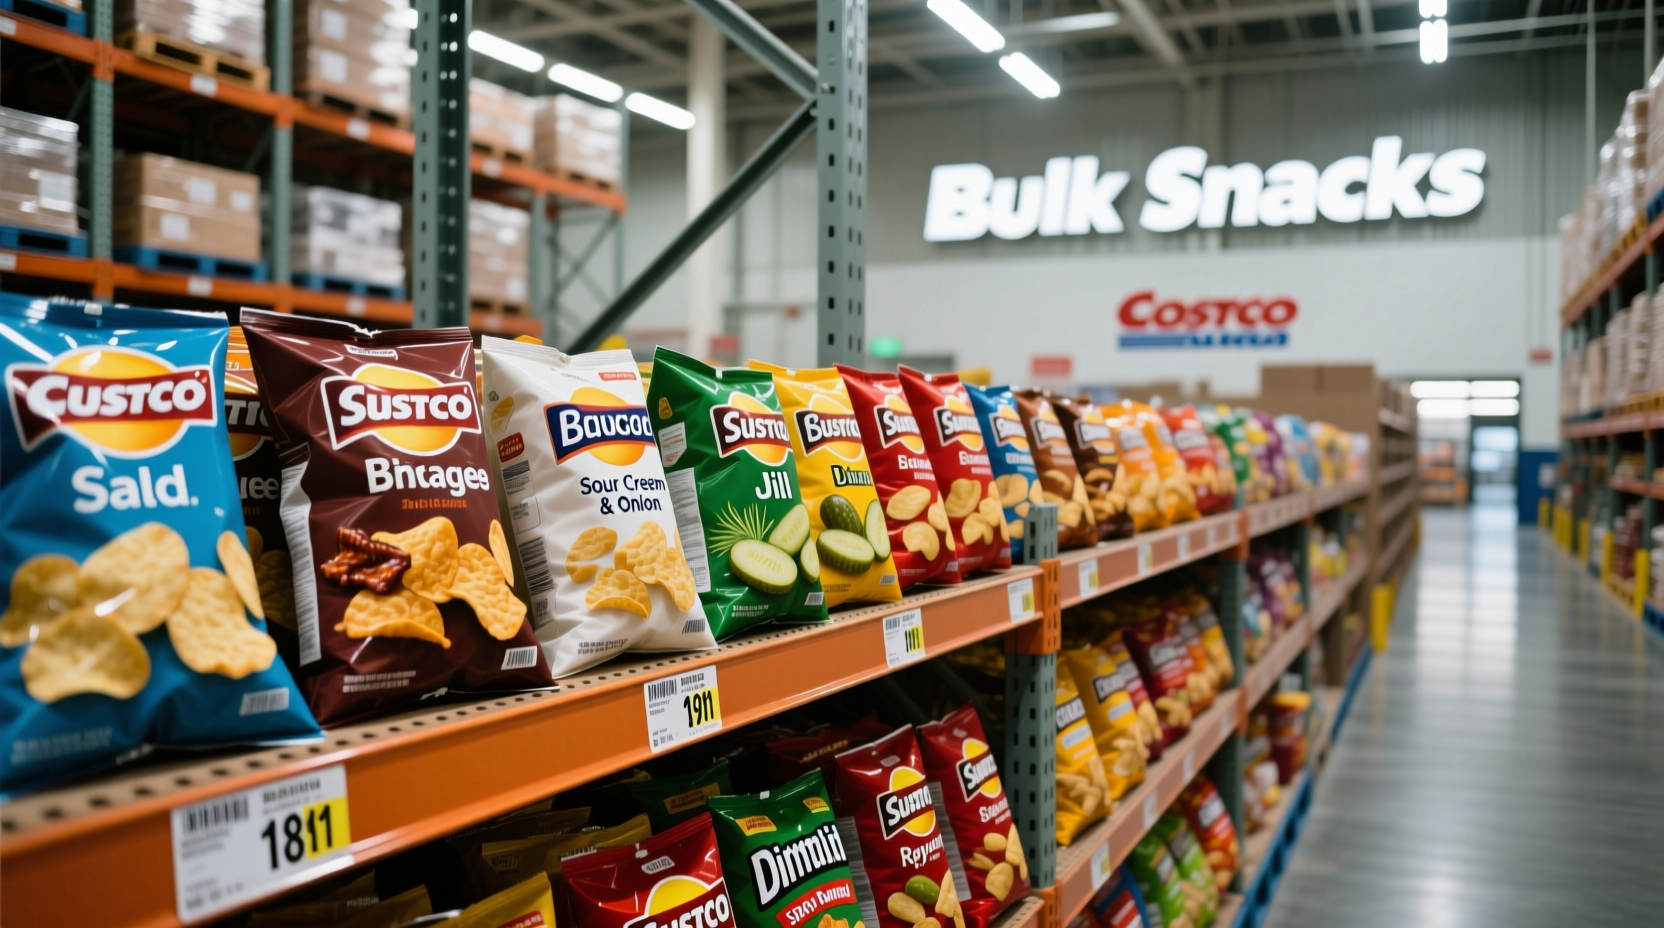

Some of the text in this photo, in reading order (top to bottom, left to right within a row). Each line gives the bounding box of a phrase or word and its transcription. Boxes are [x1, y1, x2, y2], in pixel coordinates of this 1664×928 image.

[923, 135, 1486, 241] Bulk Snacks
[580, 474, 666, 495] Sour Creem
[755, 471, 793, 499] Jill
[600, 497, 614, 515] &
